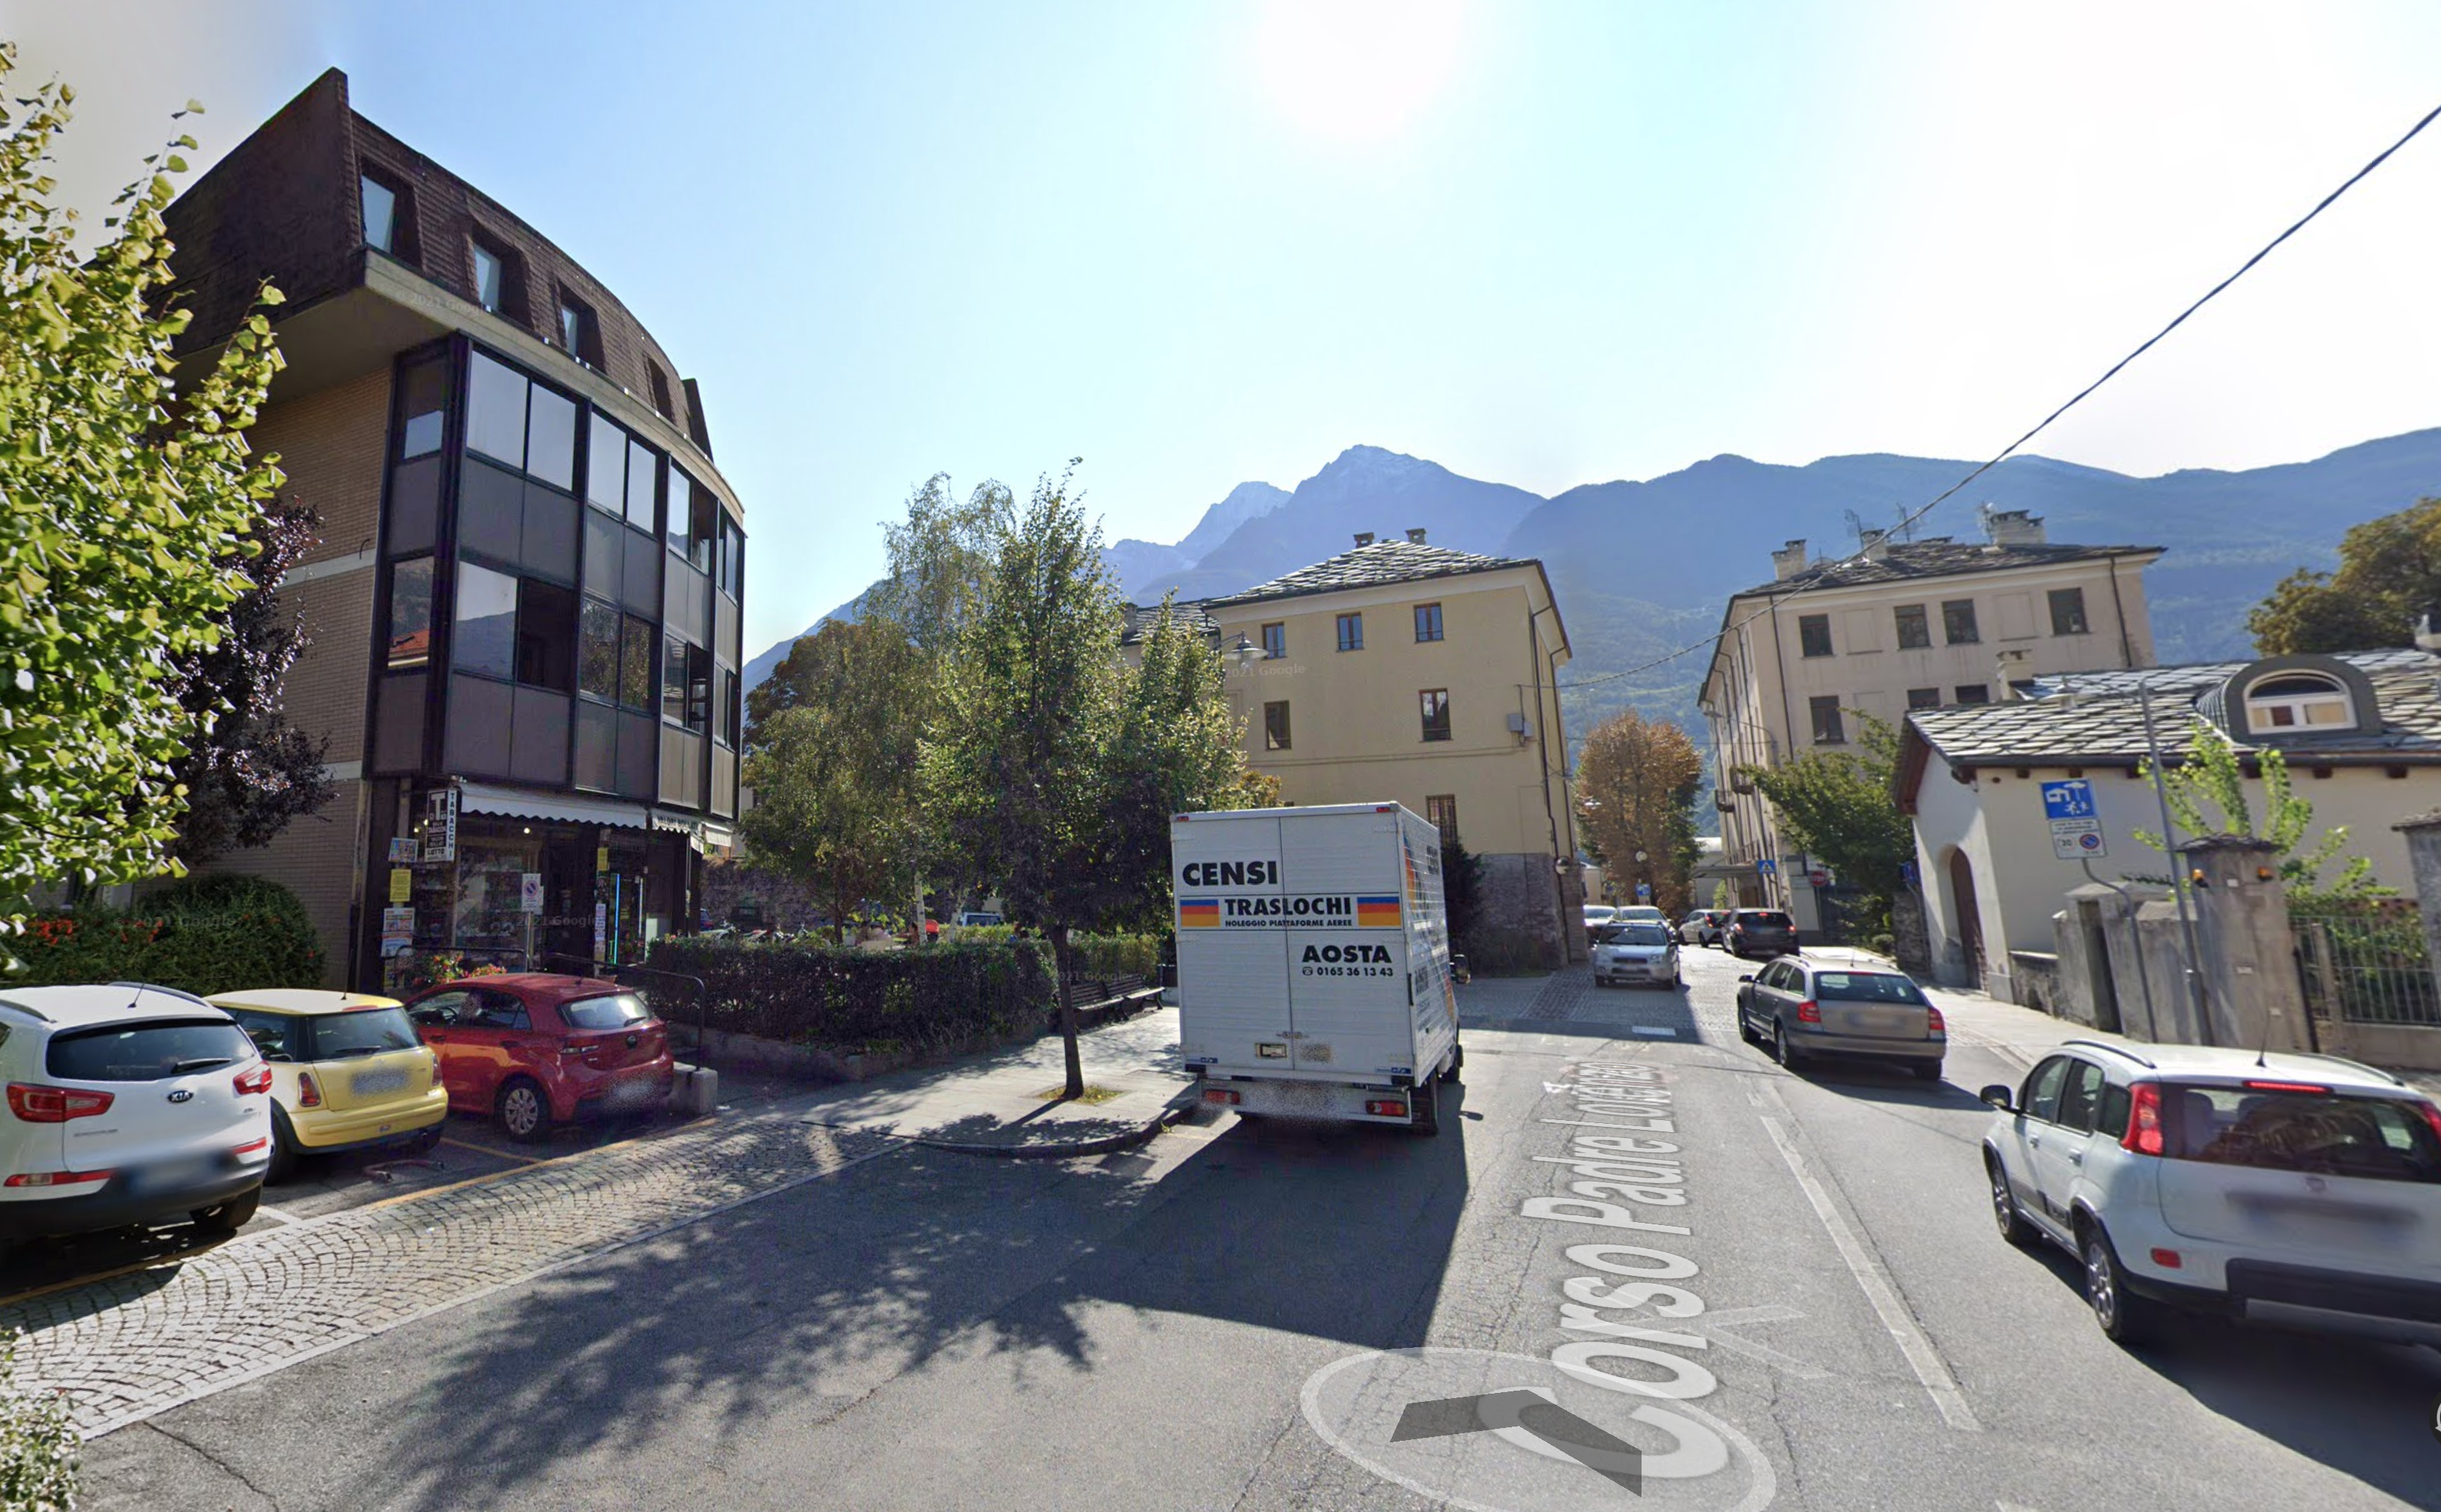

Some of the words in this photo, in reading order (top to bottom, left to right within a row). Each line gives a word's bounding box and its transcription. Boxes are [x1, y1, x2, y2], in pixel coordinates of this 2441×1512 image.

[1182, 860, 1277, 886] CENSI
[1224, 897, 1352, 916] TRASLOCHI
[1302, 945, 1392, 964] AOSTA
[1317, 967, 1343, 976] 0165
[1346, 967, 1360, 976] 36
[1364, 967, 1376, 976] 13
[1379, 967, 1394, 976] 43
[171, 1092, 190, 1101] KIA
